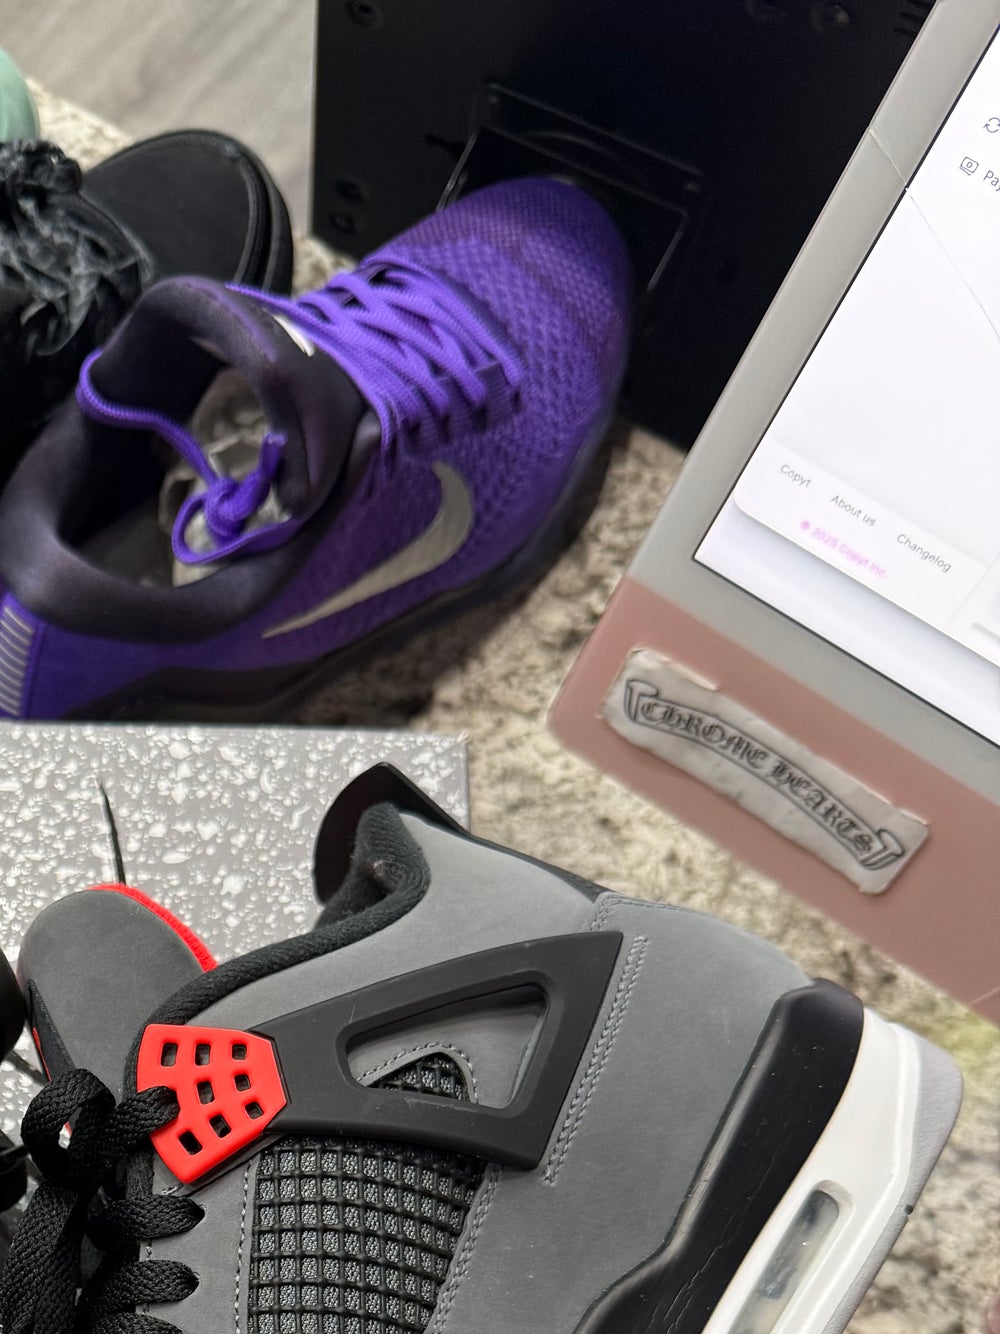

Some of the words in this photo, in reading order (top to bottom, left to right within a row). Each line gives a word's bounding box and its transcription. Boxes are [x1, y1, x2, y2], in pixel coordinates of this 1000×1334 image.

[780, 464, 812, 489] Copyt
[830, 495, 862, 519] About
[862, 512, 876, 527] us
[896, 533, 952, 574] Changelog
[641, 701, 769, 770] CHROME
[769, 760, 873, 852] HEARTS
